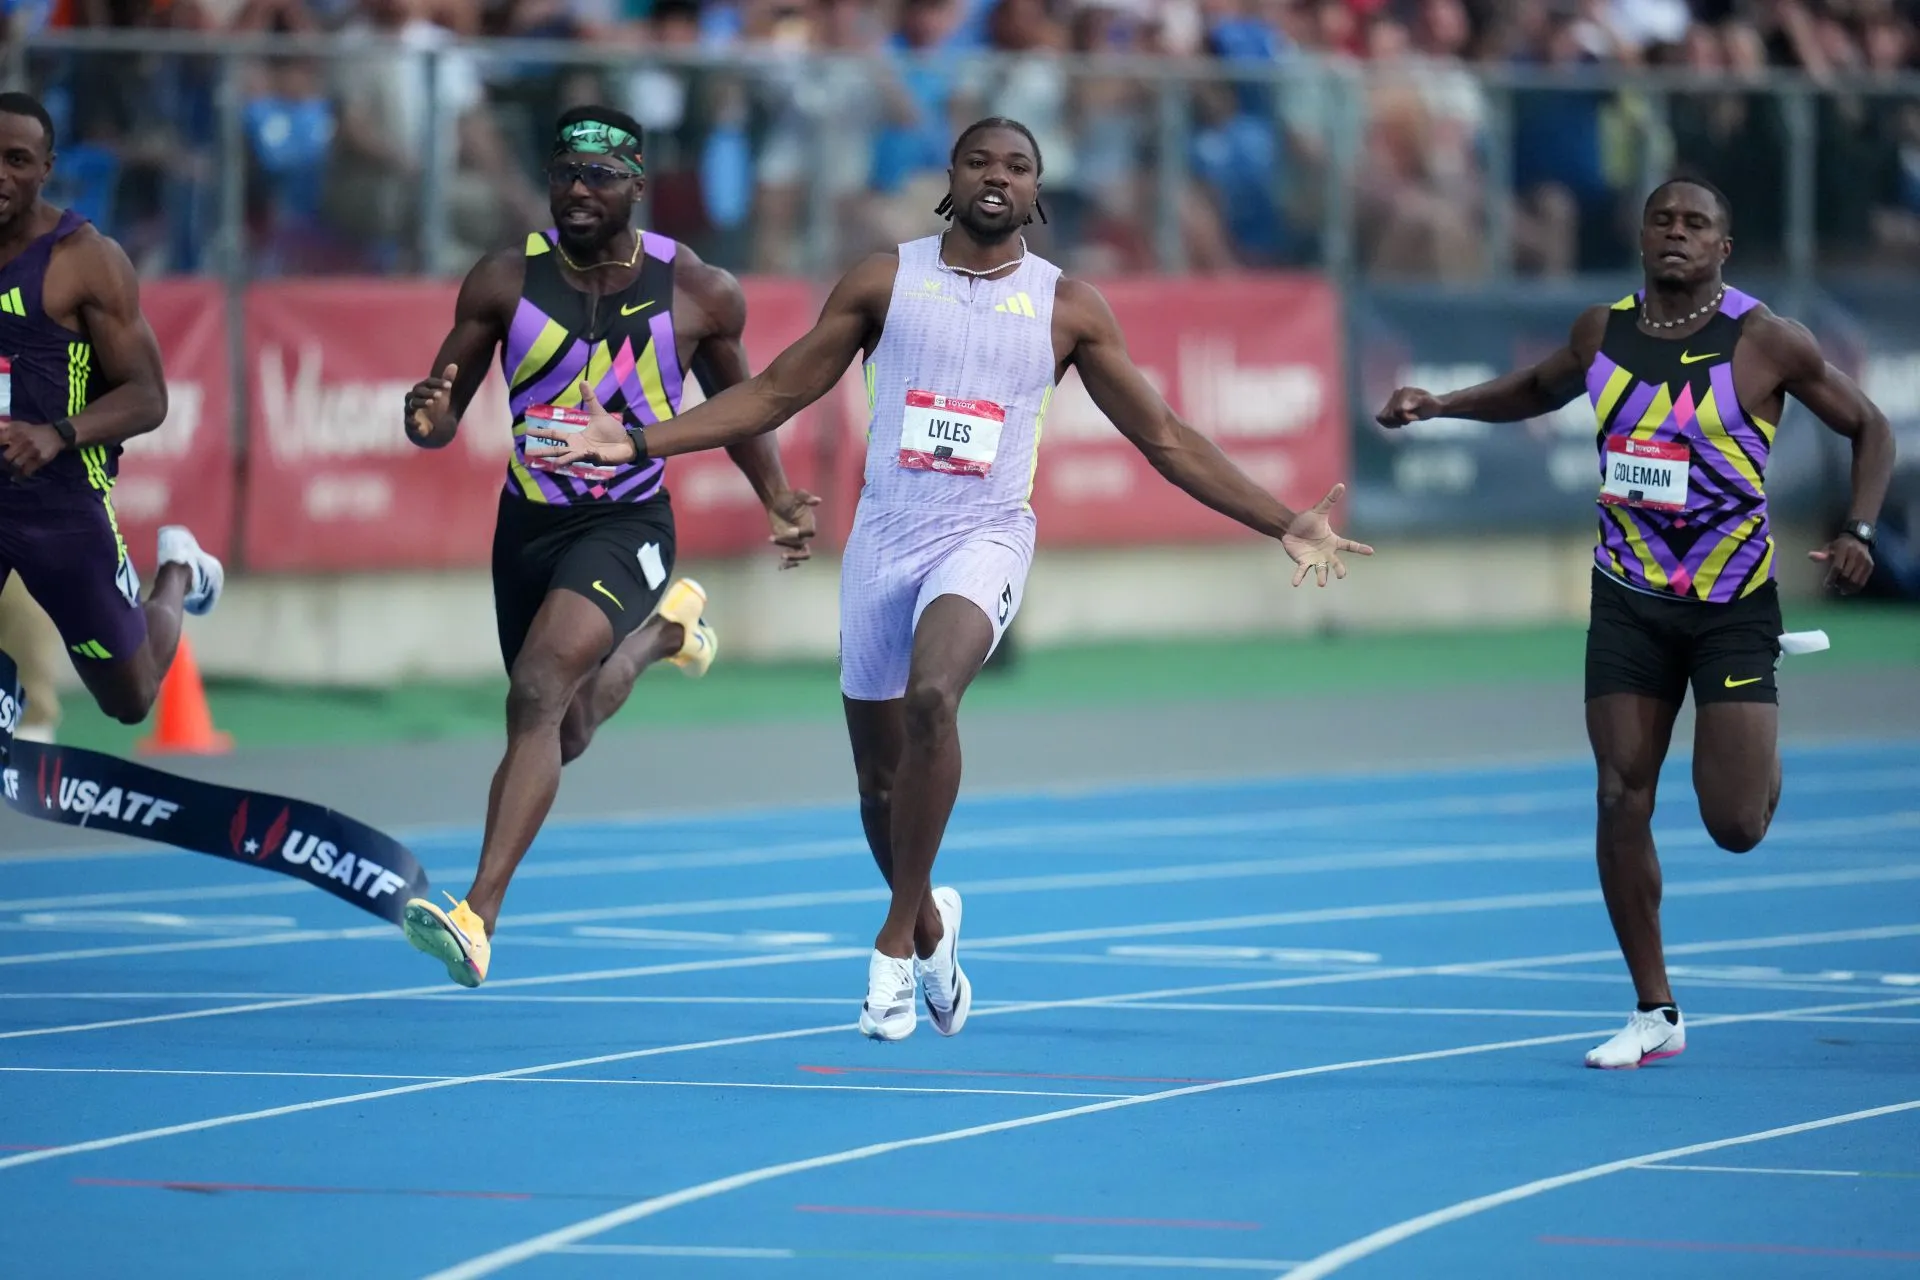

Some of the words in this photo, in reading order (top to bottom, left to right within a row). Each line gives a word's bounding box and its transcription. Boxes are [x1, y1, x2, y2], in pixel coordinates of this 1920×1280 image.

[947, 399, 976, 411] TOYOTA
[928, 418, 972, 443] LYLES
[1614, 462, 1671, 488] COLEMAN
[58, 777, 179, 827] USATF
[281, 831, 405, 900] USATF
